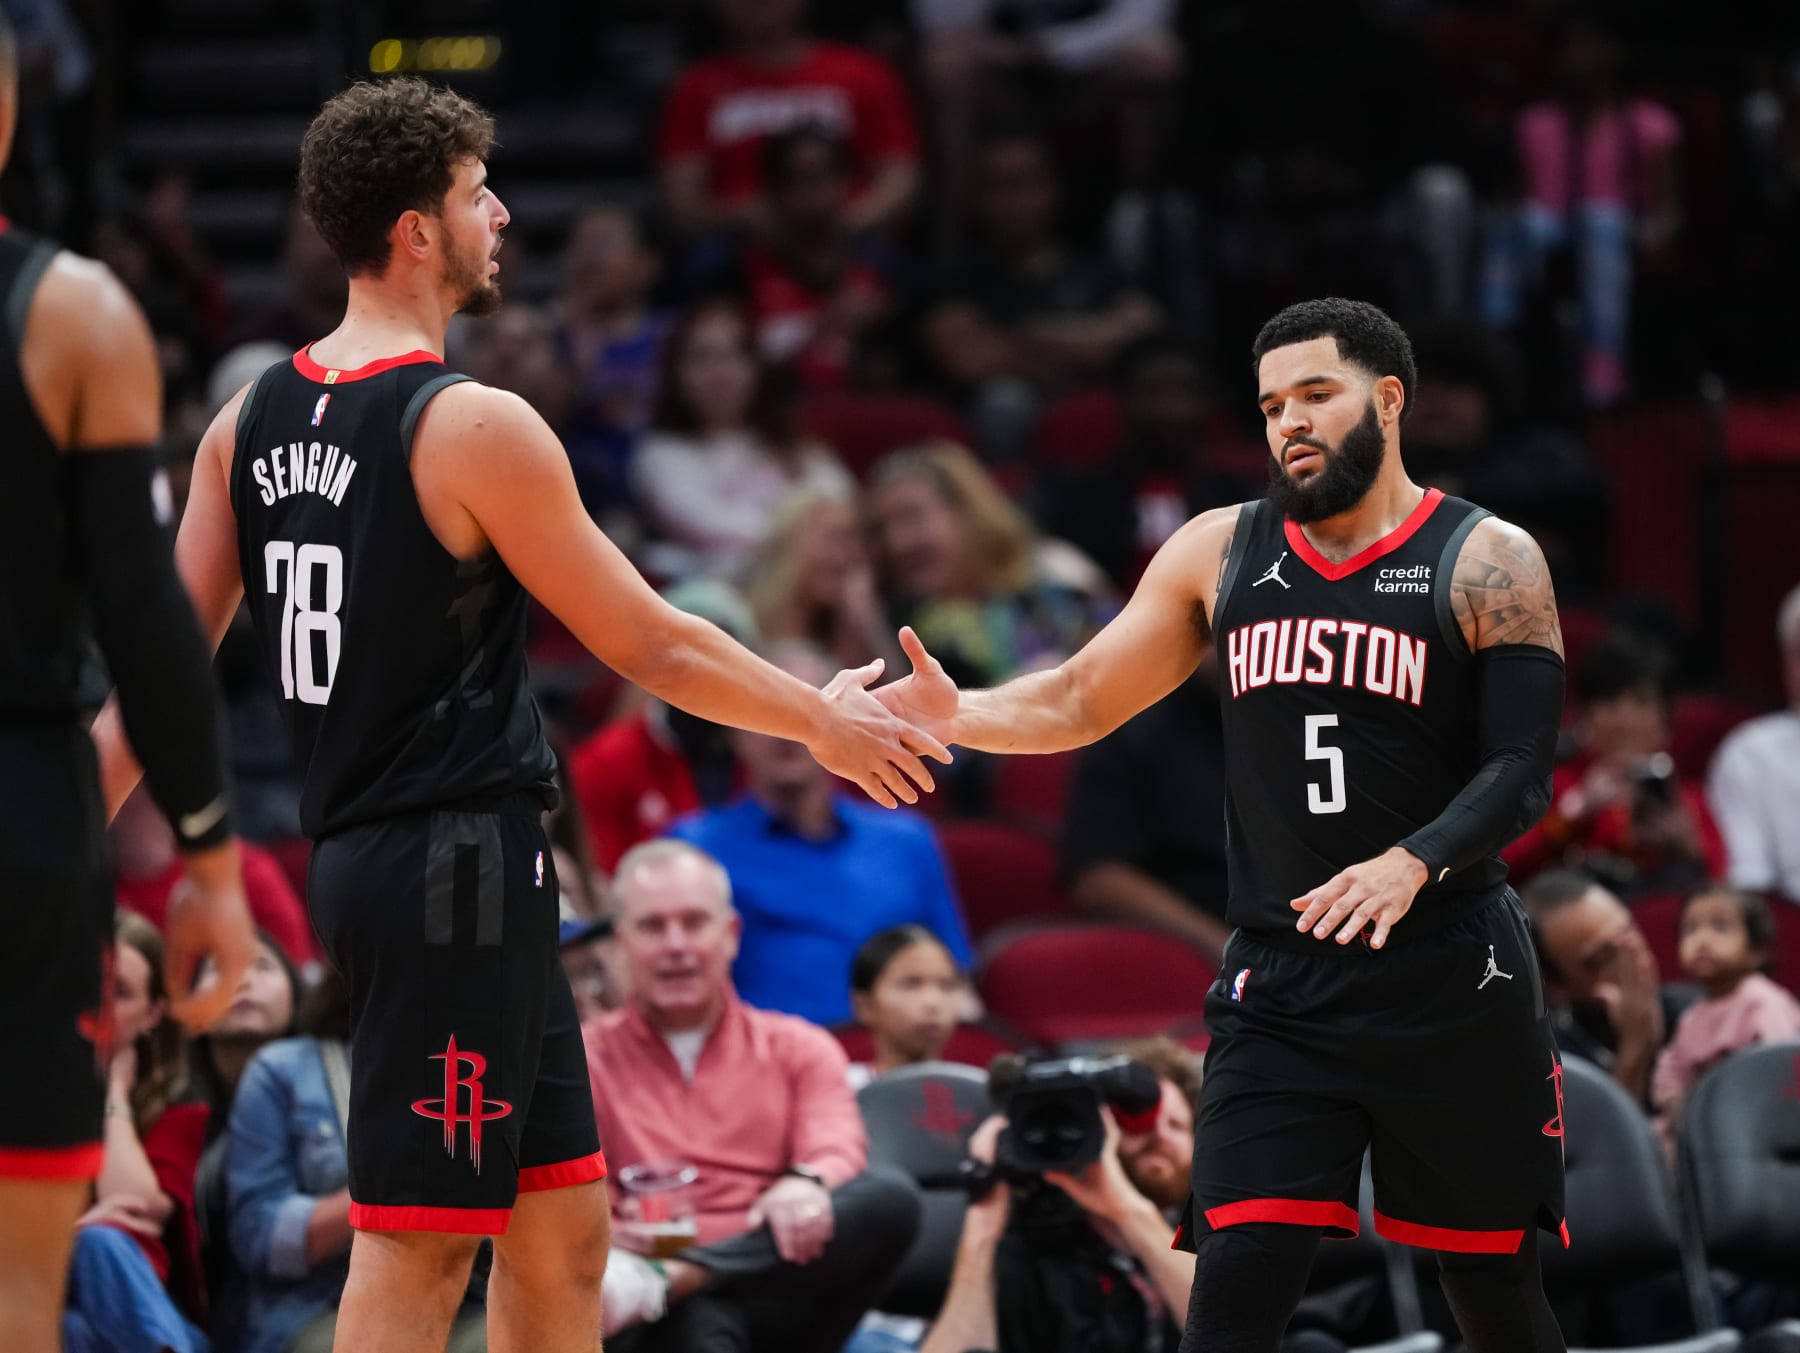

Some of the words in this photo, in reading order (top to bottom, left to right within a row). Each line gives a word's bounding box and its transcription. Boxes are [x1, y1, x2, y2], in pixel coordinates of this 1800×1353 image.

[252, 441, 358, 507] SENGUN
[1374, 578, 1429, 594] karma
[1379, 565, 1432, 579] credit
[264, 540, 343, 706] 78
[1228, 618, 1428, 707] HOUSTON
[1304, 713, 1347, 814] 5
